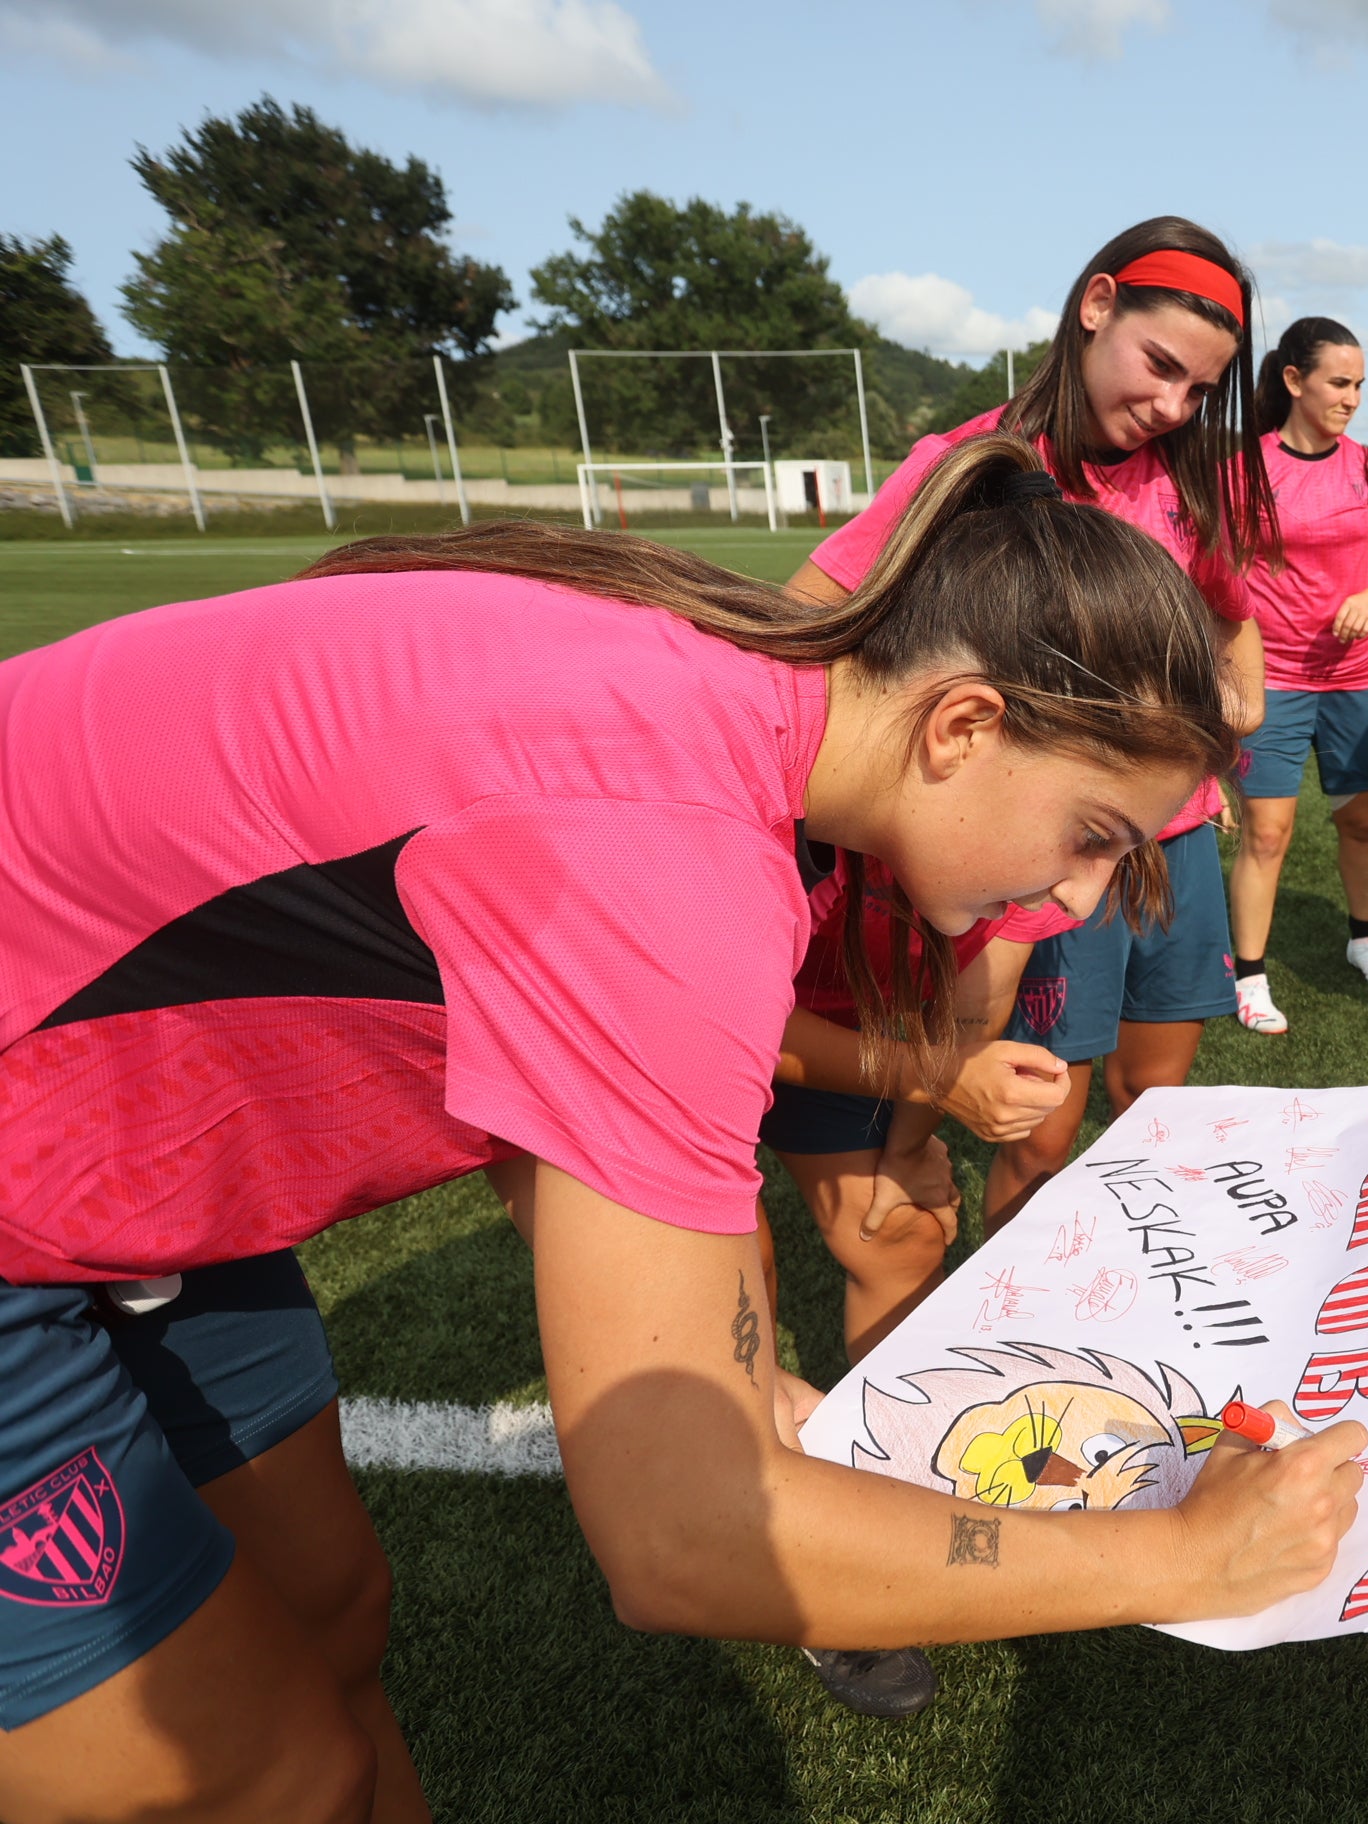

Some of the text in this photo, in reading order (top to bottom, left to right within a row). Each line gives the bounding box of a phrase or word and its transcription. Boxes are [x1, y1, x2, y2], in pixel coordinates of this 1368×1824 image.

[1204, 1160, 1298, 1236] AUPA
[50, 1456, 89, 1489] CLUB
[52, 1546, 115, 1600] BILBAO
